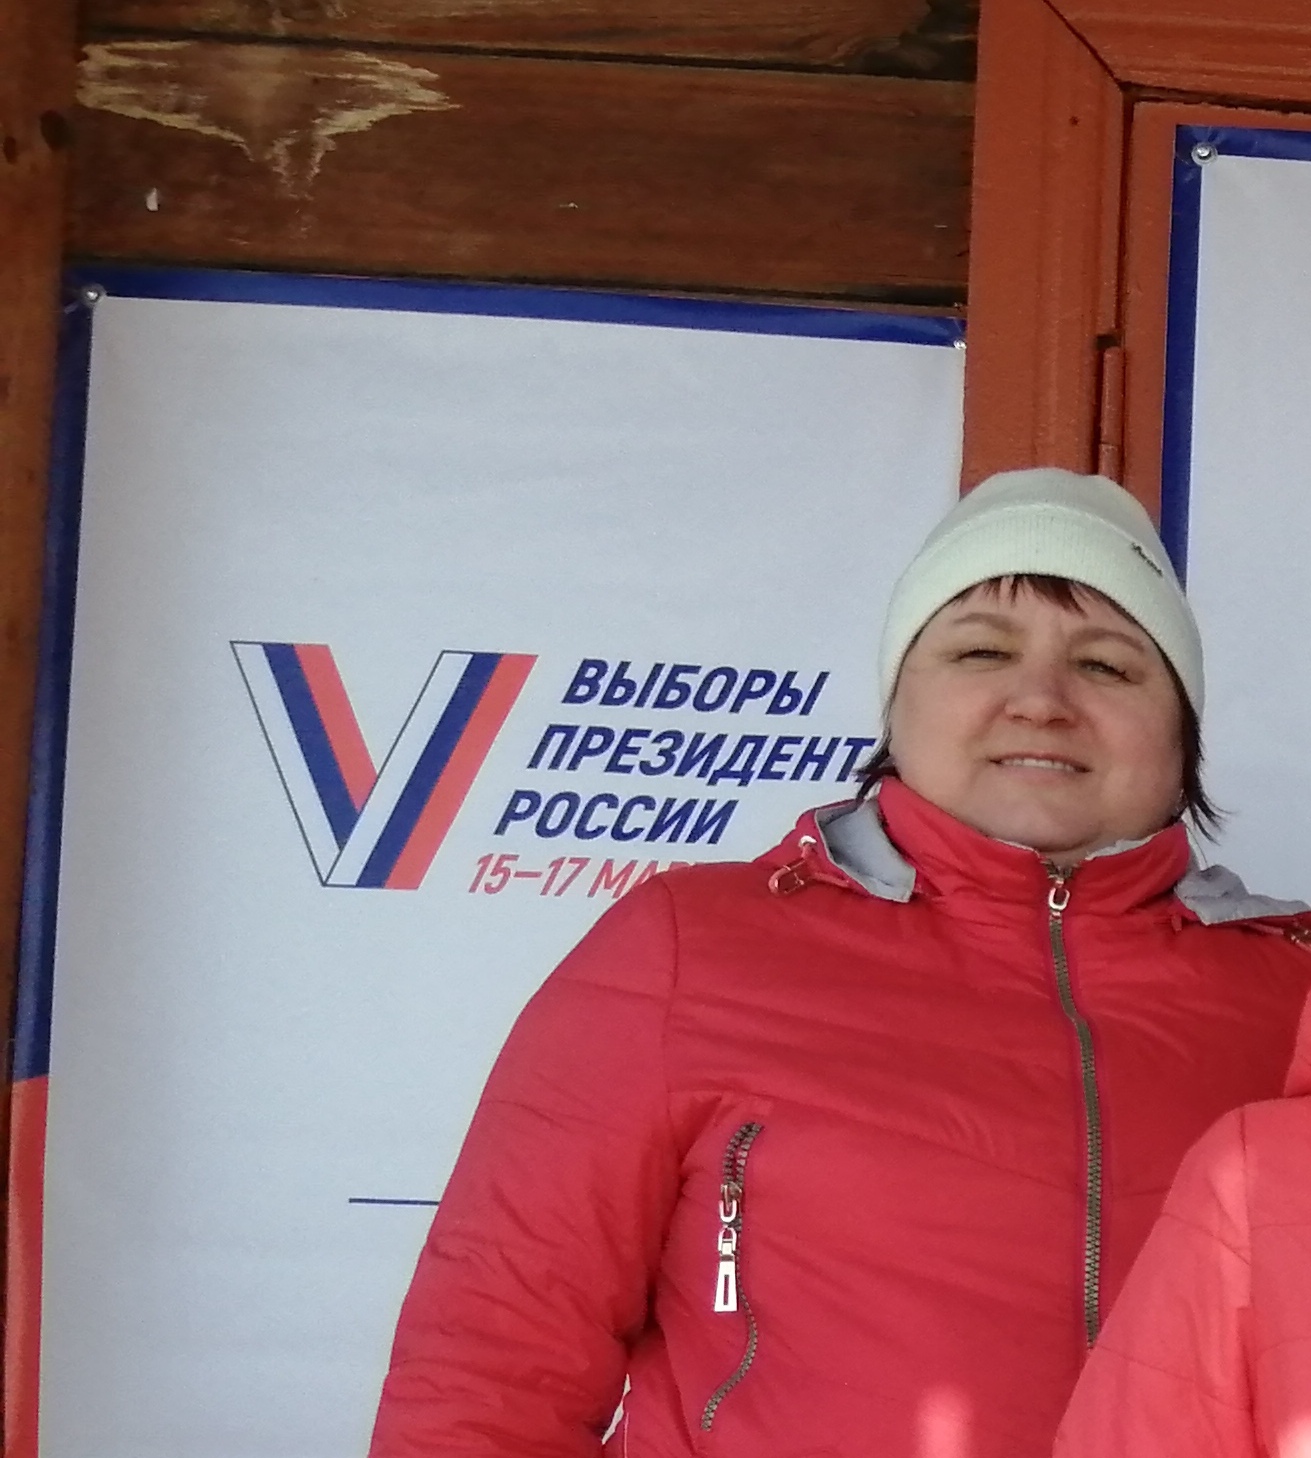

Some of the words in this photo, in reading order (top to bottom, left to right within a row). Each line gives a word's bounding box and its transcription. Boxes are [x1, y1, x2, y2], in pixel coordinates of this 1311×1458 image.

[561, 658, 830, 716] ВЫБОРЫ
[526, 724, 878, 787] ПРЕЗИДЕНТ
[493, 789, 740, 845] РОССИИ
